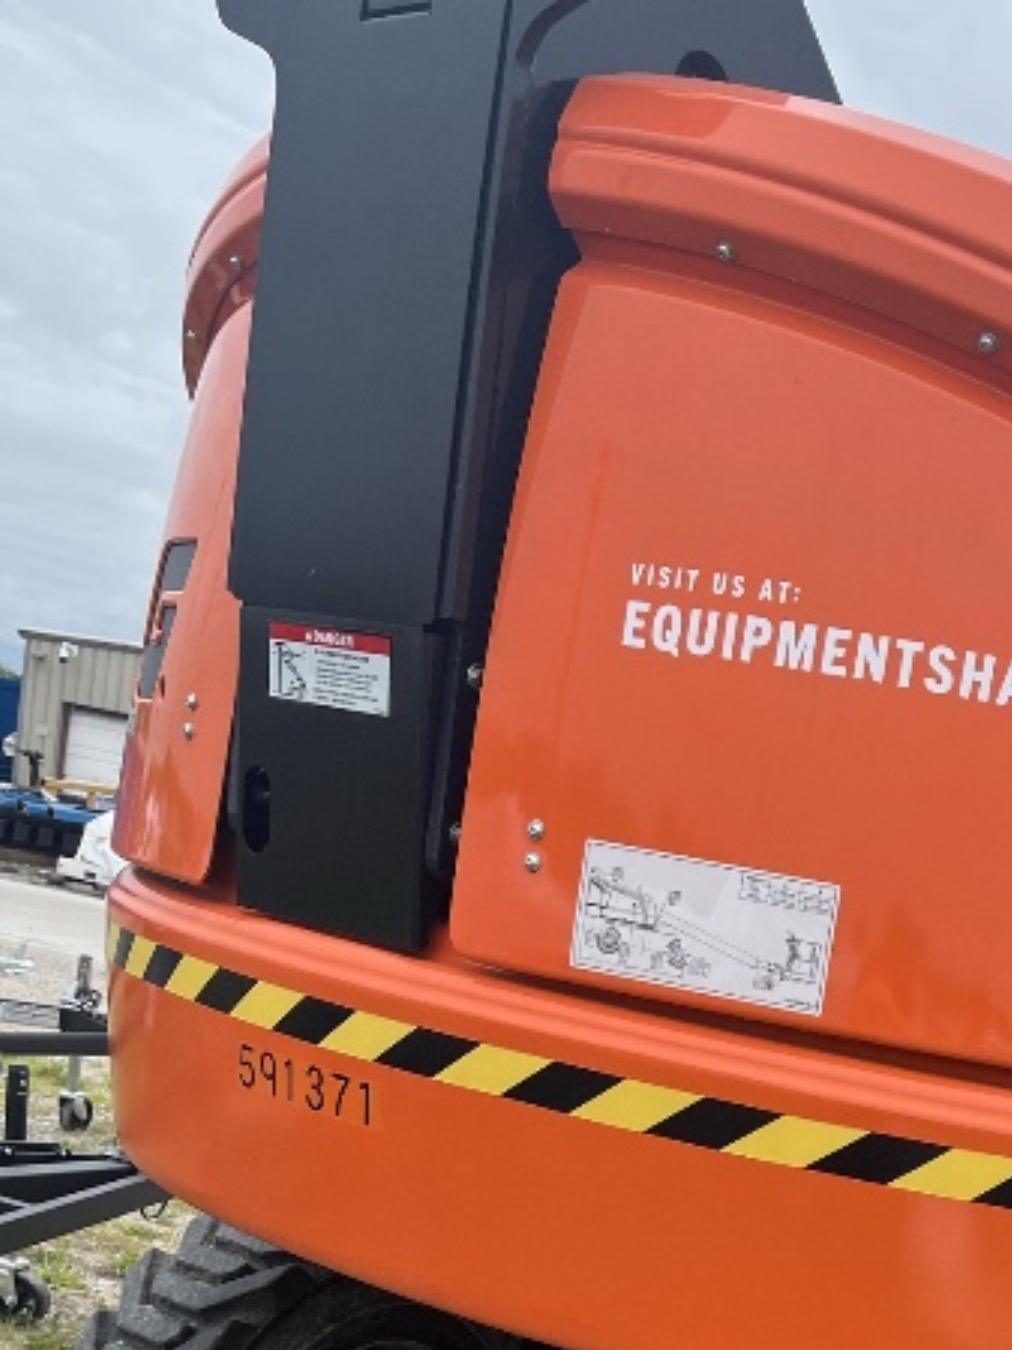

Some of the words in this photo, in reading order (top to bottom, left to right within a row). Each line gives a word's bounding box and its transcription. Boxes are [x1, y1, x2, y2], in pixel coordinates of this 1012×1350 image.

[631, 563, 700, 592] VISIT
[713, 572, 745, 598] US
[758, 578, 801, 603] AT:
[239, 1044, 371, 1126] 591371
